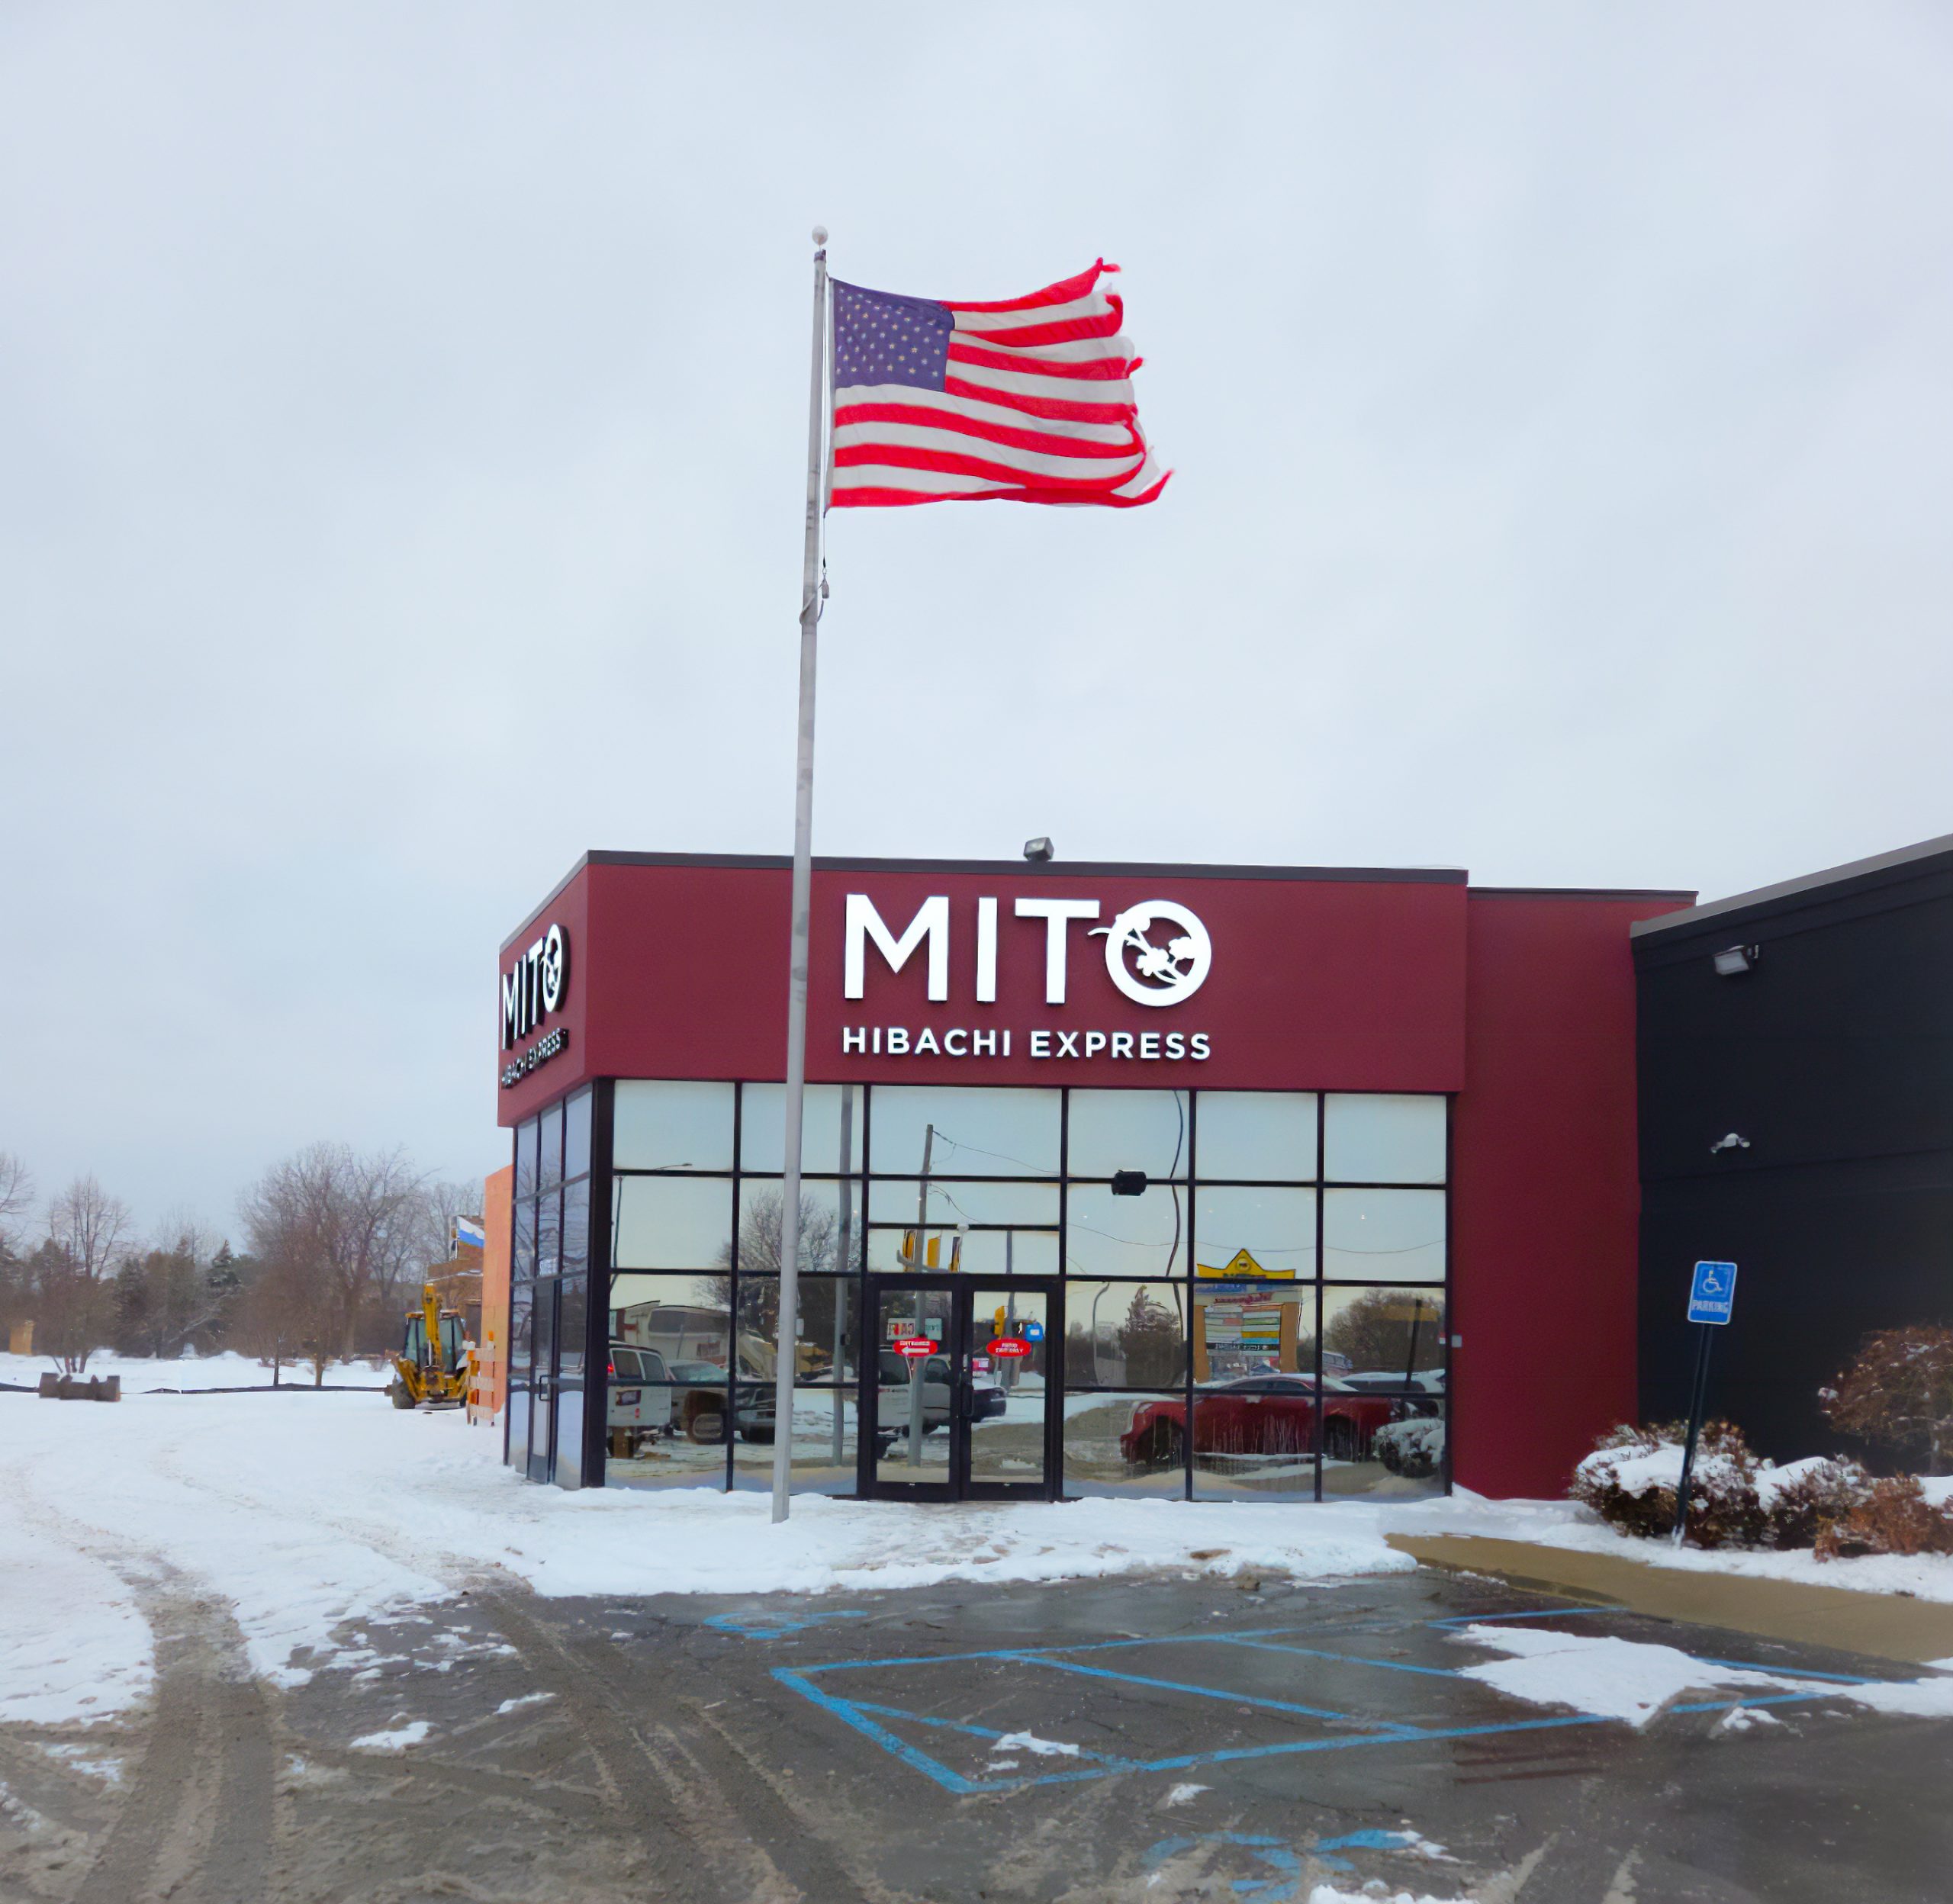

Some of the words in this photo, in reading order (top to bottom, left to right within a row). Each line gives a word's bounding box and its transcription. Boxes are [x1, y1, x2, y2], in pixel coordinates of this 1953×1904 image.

[502, 923, 563, 1050] MITO
[844, 893, 1212, 1007] MITO
[842, 1026, 1011, 1057] HIBACHI
[1031, 1030, 1211, 1060] EXPRESS
